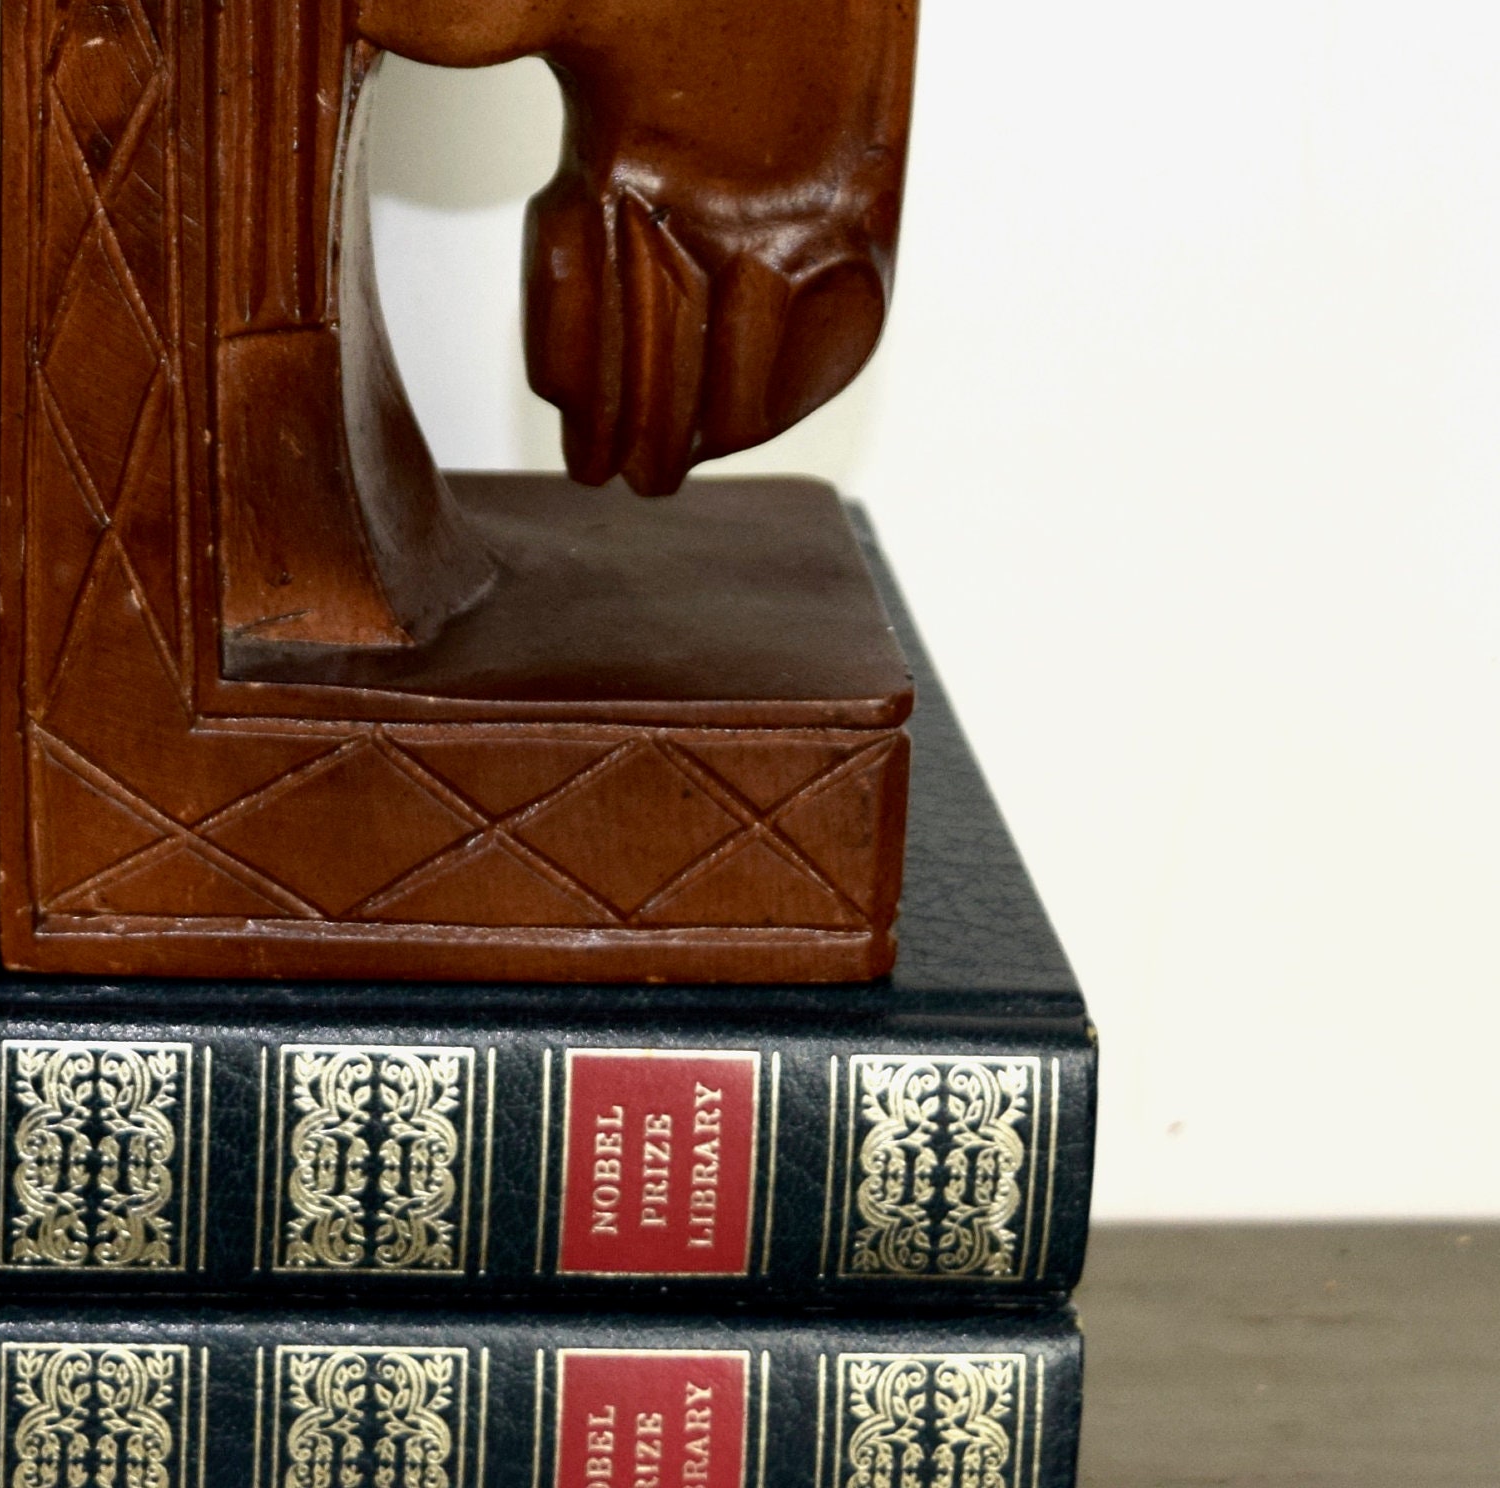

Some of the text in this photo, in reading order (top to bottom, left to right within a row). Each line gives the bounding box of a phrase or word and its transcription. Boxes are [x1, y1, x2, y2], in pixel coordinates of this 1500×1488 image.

[591, 1105, 624, 1234] NOBEL
[640, 1114, 673, 1226] PRIZE
[688, 1081, 723, 1247] LIBRARY
[683, 1381, 713, 1488] RARY
